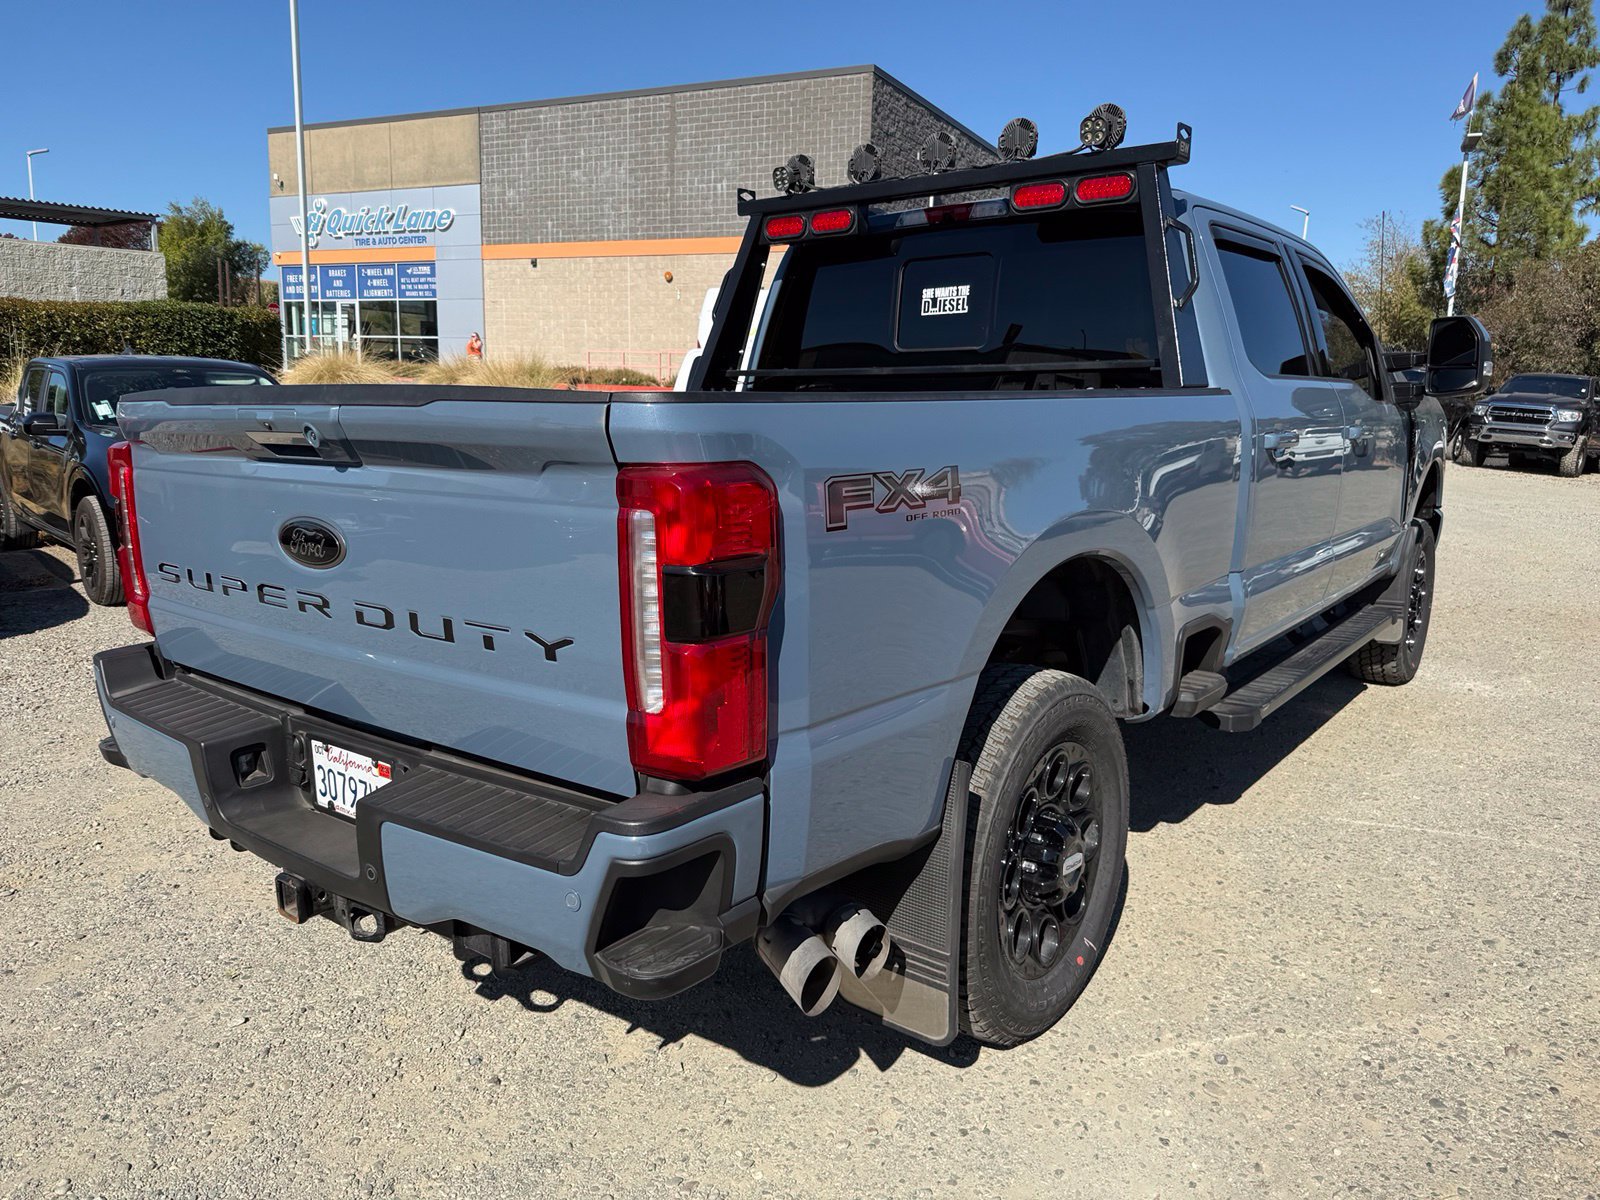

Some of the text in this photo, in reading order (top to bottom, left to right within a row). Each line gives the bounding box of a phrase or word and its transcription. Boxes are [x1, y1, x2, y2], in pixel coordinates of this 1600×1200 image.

[326, 204, 455, 239] Quick Lane
[354, 236, 427, 246] TIRE & AUTO CENTER
[328, 269, 346, 277] BRAKES
[361, 268, 393, 276] 2-WHEEL AND
[286, 275, 298, 283] FREE
[333, 279, 343, 287] AND
[286, 286, 295, 294] AND
[325, 289, 351, 297] BATTERIES
[363, 289, 393, 297] ALIGNMENTS
[922, 285, 970, 298] SHE WANTS THE
[824, 465, 961, 532] FX4
[906, 508, 961, 522] OFF ROAD
[290, 528, 325, 558] Ford
[157, 562, 575, 663] SUPER DUTY
[327, 746, 378, 777] California
